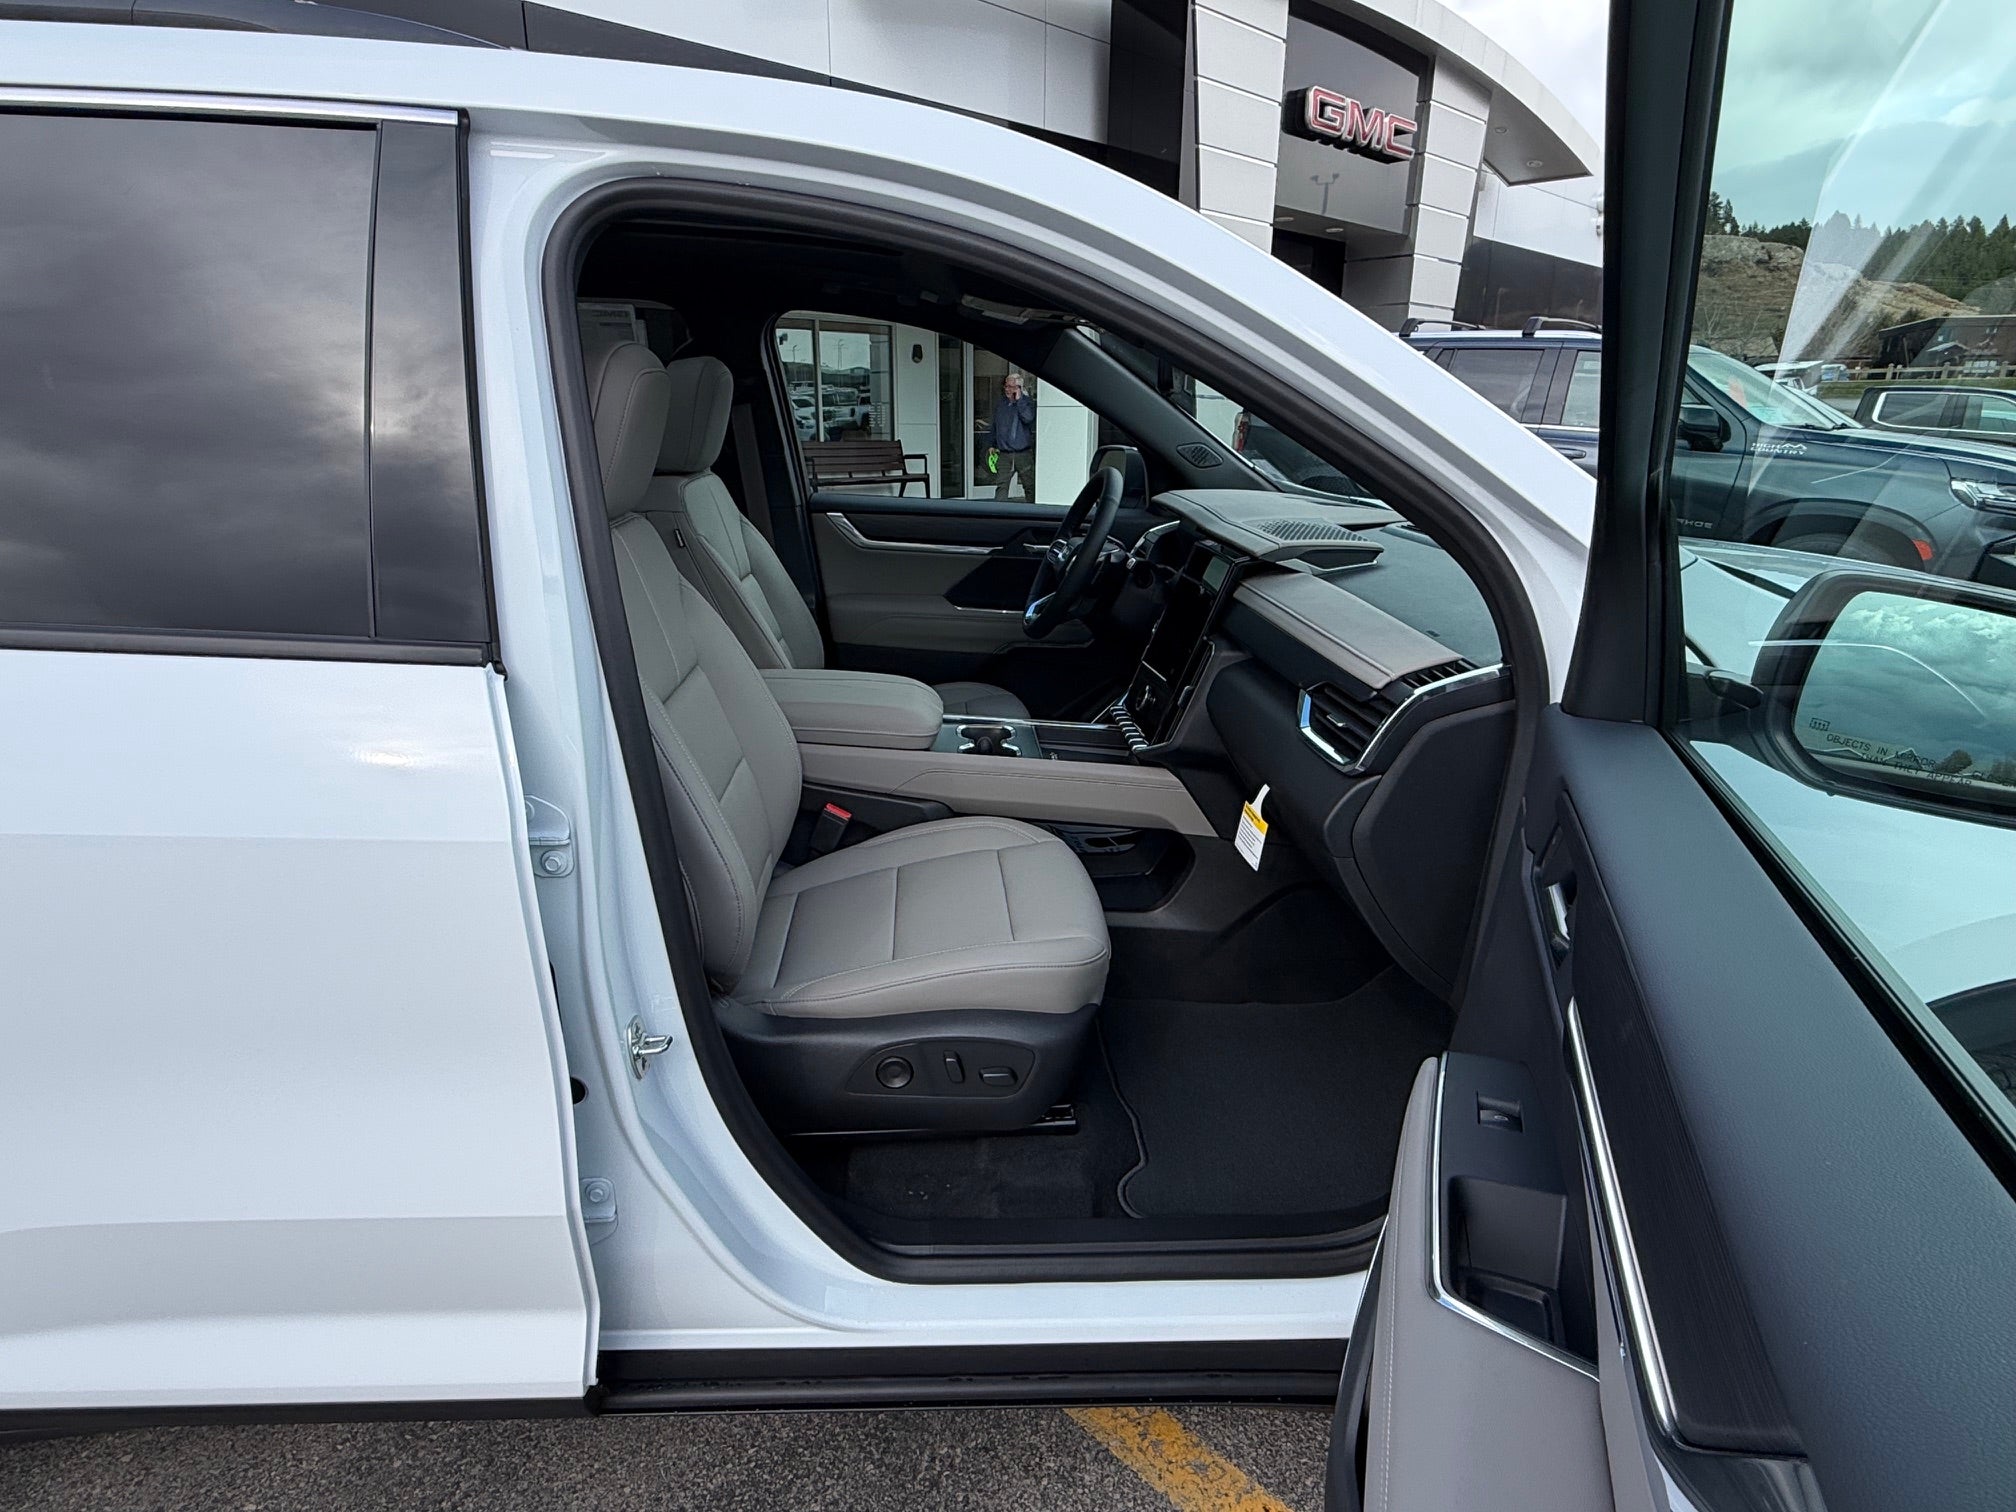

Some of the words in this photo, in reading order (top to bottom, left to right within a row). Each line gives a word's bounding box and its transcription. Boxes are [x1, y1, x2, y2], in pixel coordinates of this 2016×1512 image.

[1305, 85, 1418, 160] GMC
[1826, 733, 1872, 752] OBJECTS
[1876, 746, 1888, 756] IN
[1893, 761, 1921, 775] THEY
[1926, 772, 1973, 786] APPEAR
